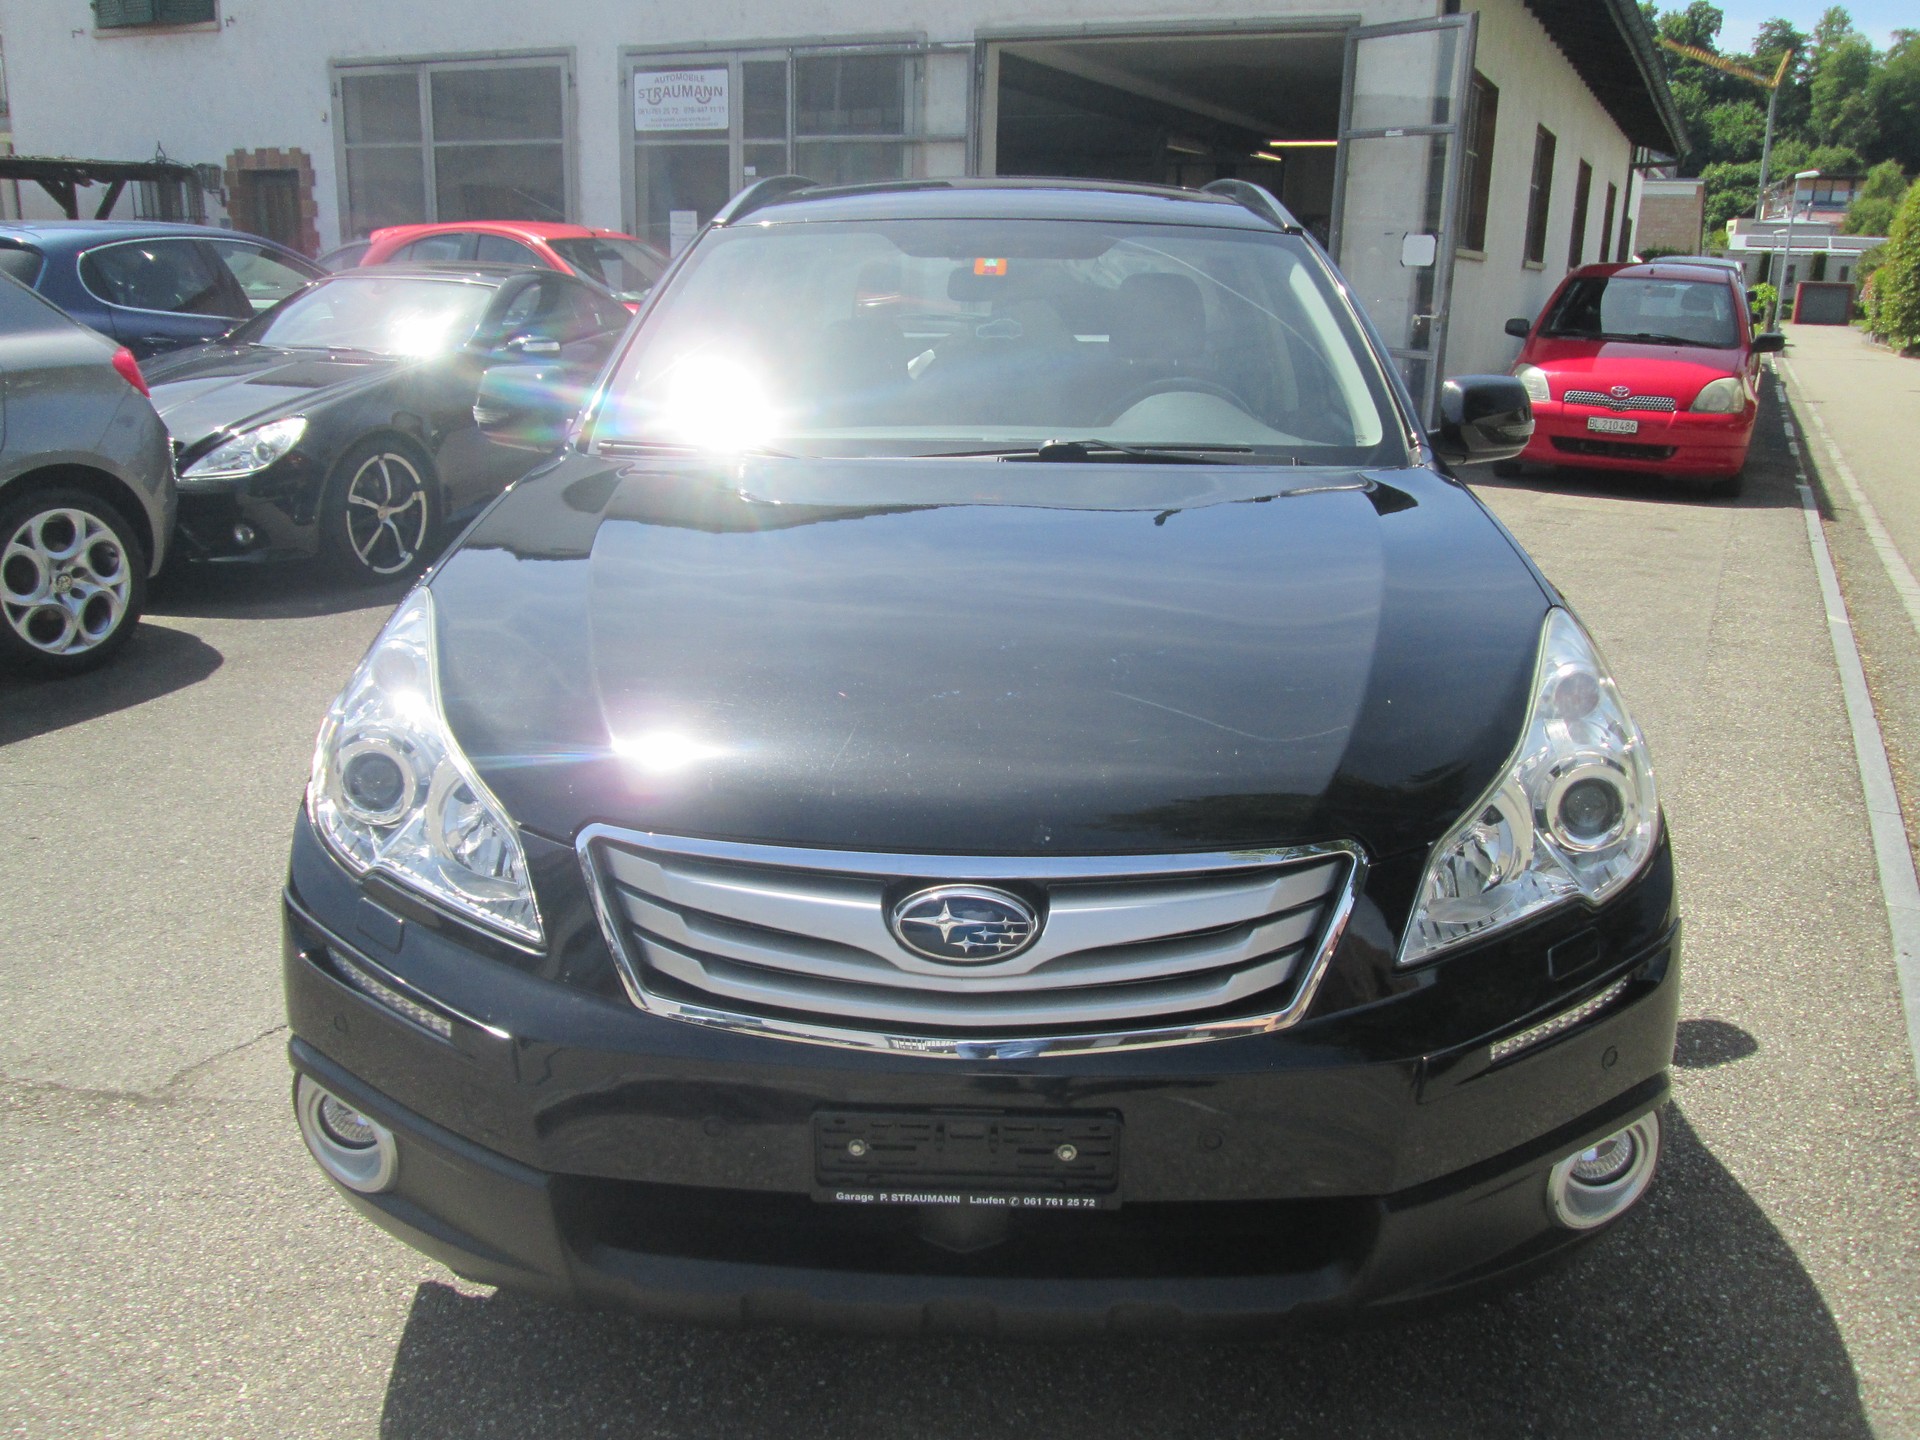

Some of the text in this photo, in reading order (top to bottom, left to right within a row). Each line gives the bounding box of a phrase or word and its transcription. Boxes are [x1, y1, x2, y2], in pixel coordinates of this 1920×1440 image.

[654, 73, 705, 83] AUTOMOBILE
[638, 85, 723, 99] STRAUMANN
[1589, 418, 1599, 429] BL
[836, 1192, 874, 1202] Garage
[880, 1193, 888, 1201] P.
[891, 1193, 961, 1203] STRAUMANN
[969, 1195, 1006, 1204] Laufen
[1023, 1197, 1042, 1206] 061
[1045, 1198, 1063, 1206] 761
[1082, 1199, 1096, 1207] 72
